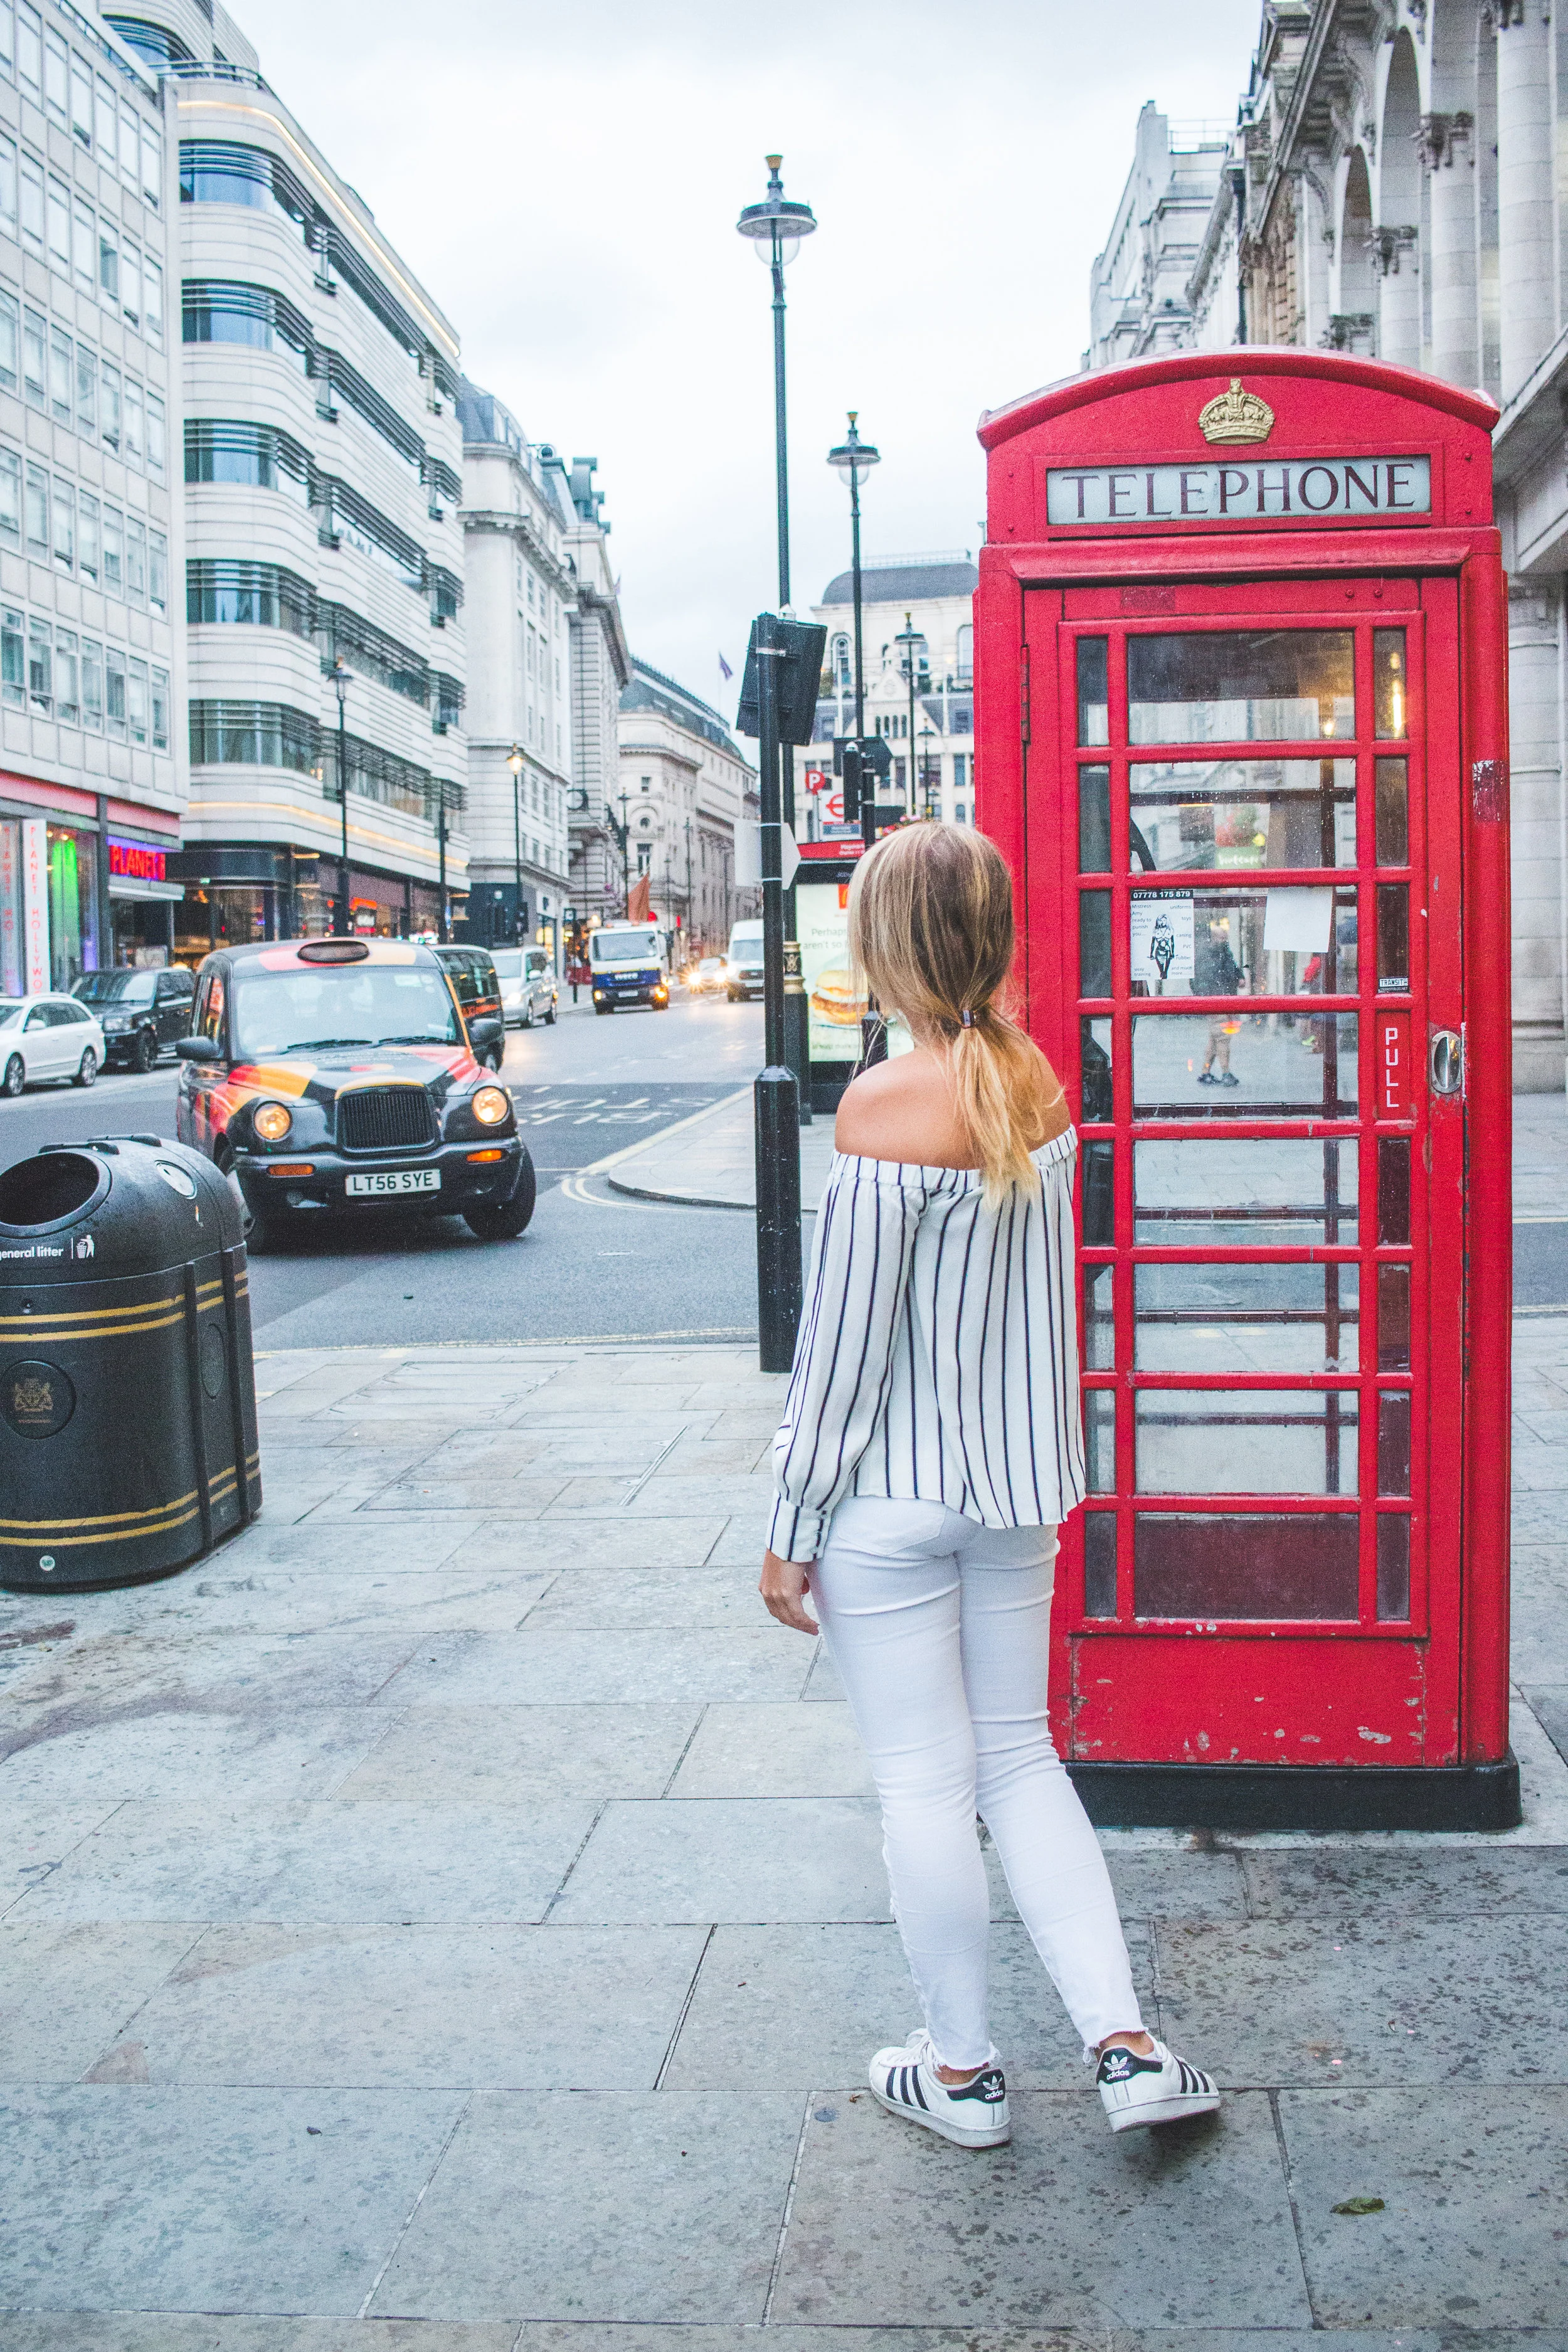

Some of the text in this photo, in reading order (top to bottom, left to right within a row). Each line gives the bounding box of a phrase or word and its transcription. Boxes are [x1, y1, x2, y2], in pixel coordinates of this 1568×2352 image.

[1062, 463, 1416, 518] TELEPHONE
[808, 773, 820, 790] P
[29, 826, 39, 894] PLANET
[1385, 1027, 1399, 1108] PULL
[353, 1172, 433, 1191] LT56 SYE
[0, 1245, 64, 1261] eneral litter
[1106, 2070, 1130, 2080] adidas
